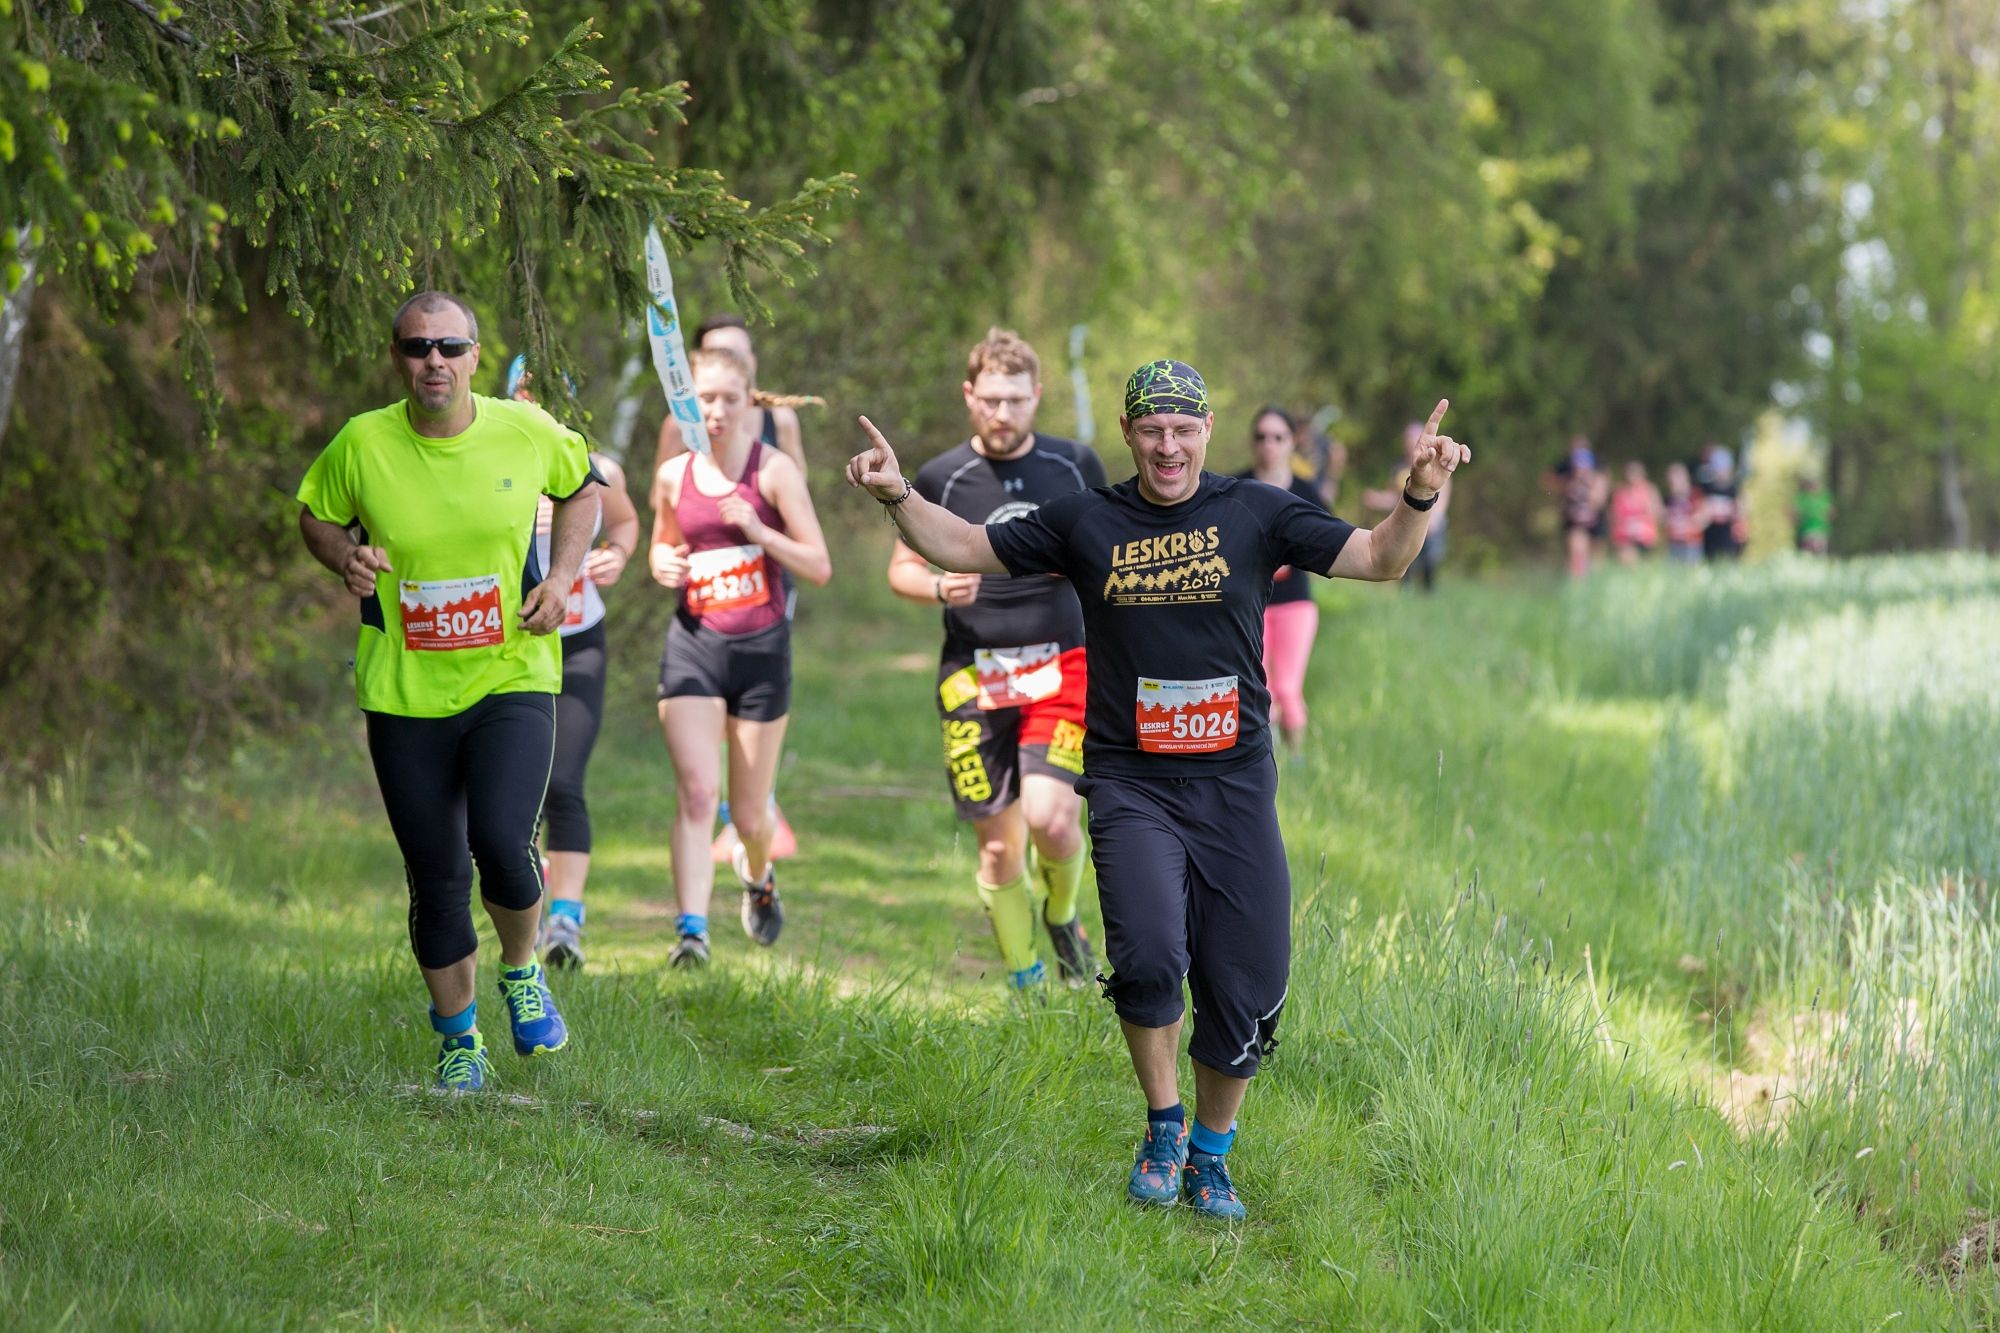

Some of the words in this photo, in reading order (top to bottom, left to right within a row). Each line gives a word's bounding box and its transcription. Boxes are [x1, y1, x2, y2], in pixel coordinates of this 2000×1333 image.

[1181, 573, 1221, 592] 2019
[436, 606, 502, 638] 5024
[1172, 710, 1237, 739] 5026
